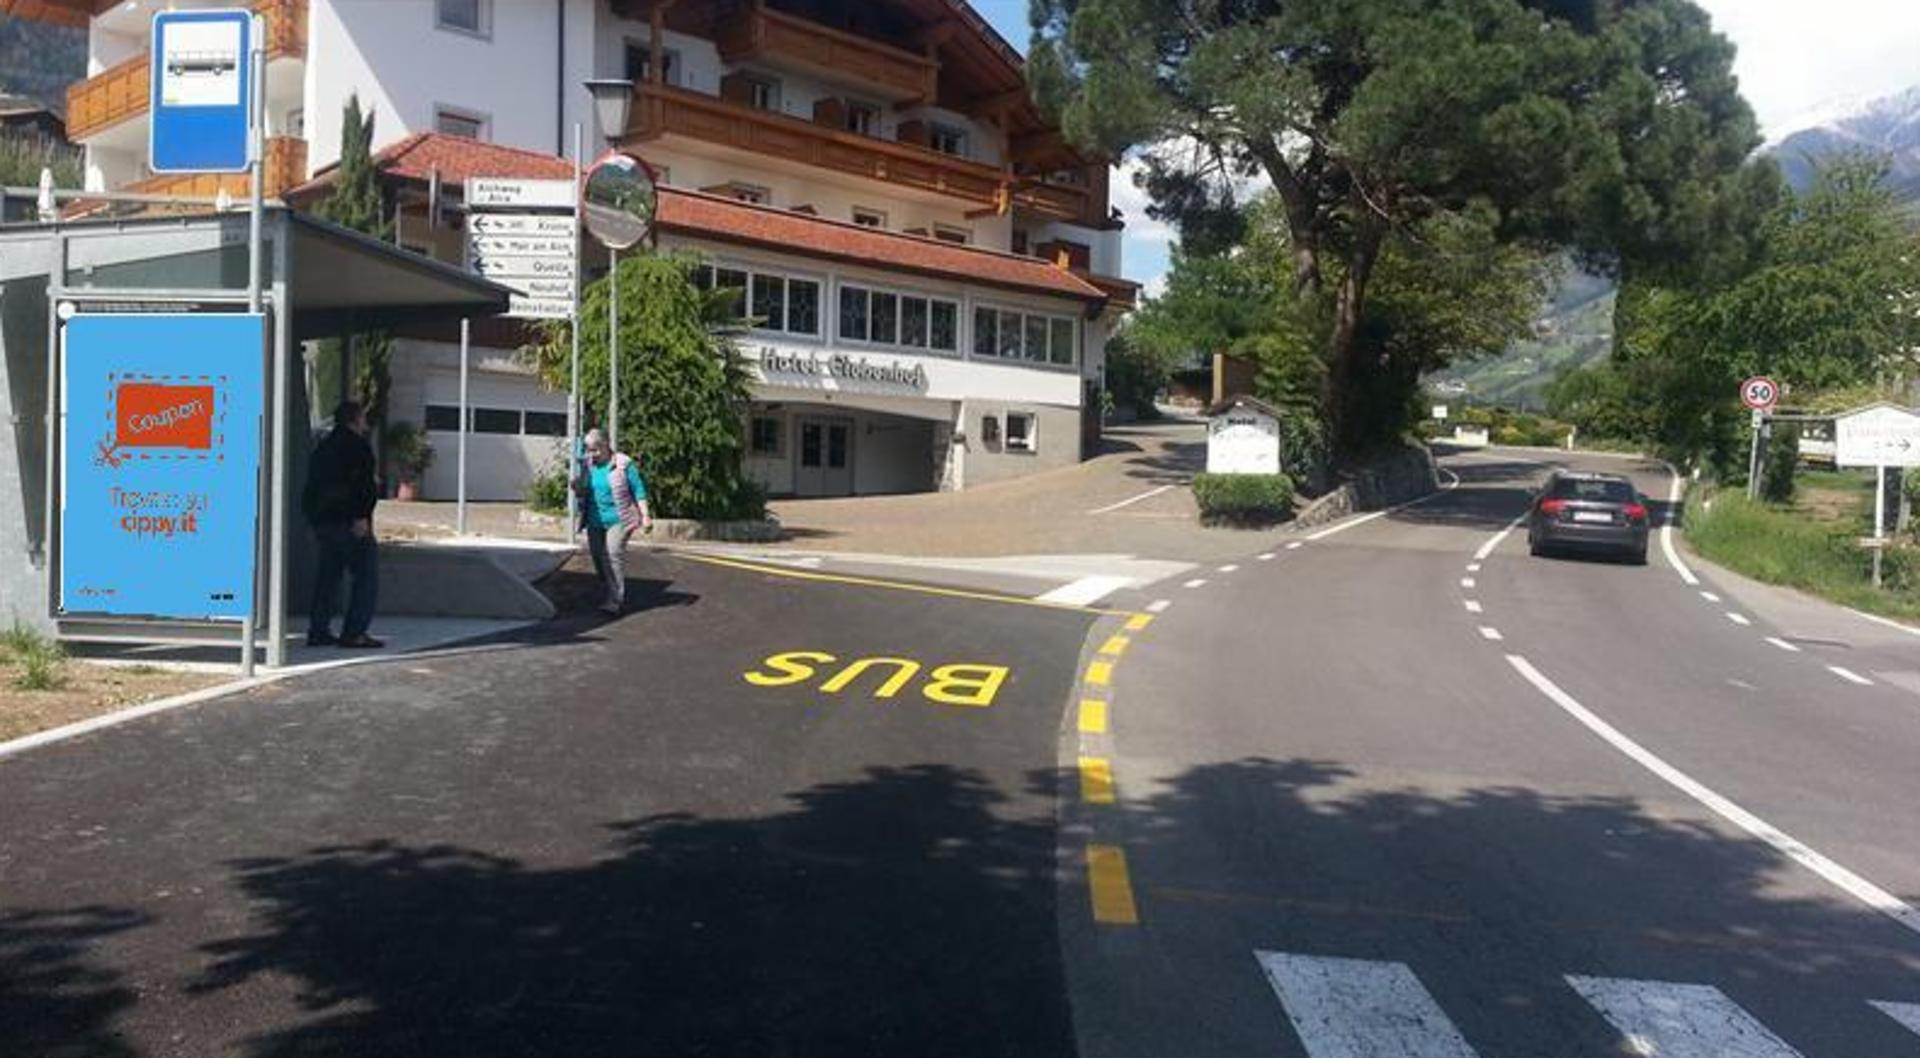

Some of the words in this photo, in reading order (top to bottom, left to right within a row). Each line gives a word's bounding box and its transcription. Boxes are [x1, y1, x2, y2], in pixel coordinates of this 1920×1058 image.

[1750, 385, 1770, 400] 50
[128, 400, 205, 433] Coupon
[743, 651, 1010, 706] BUS
